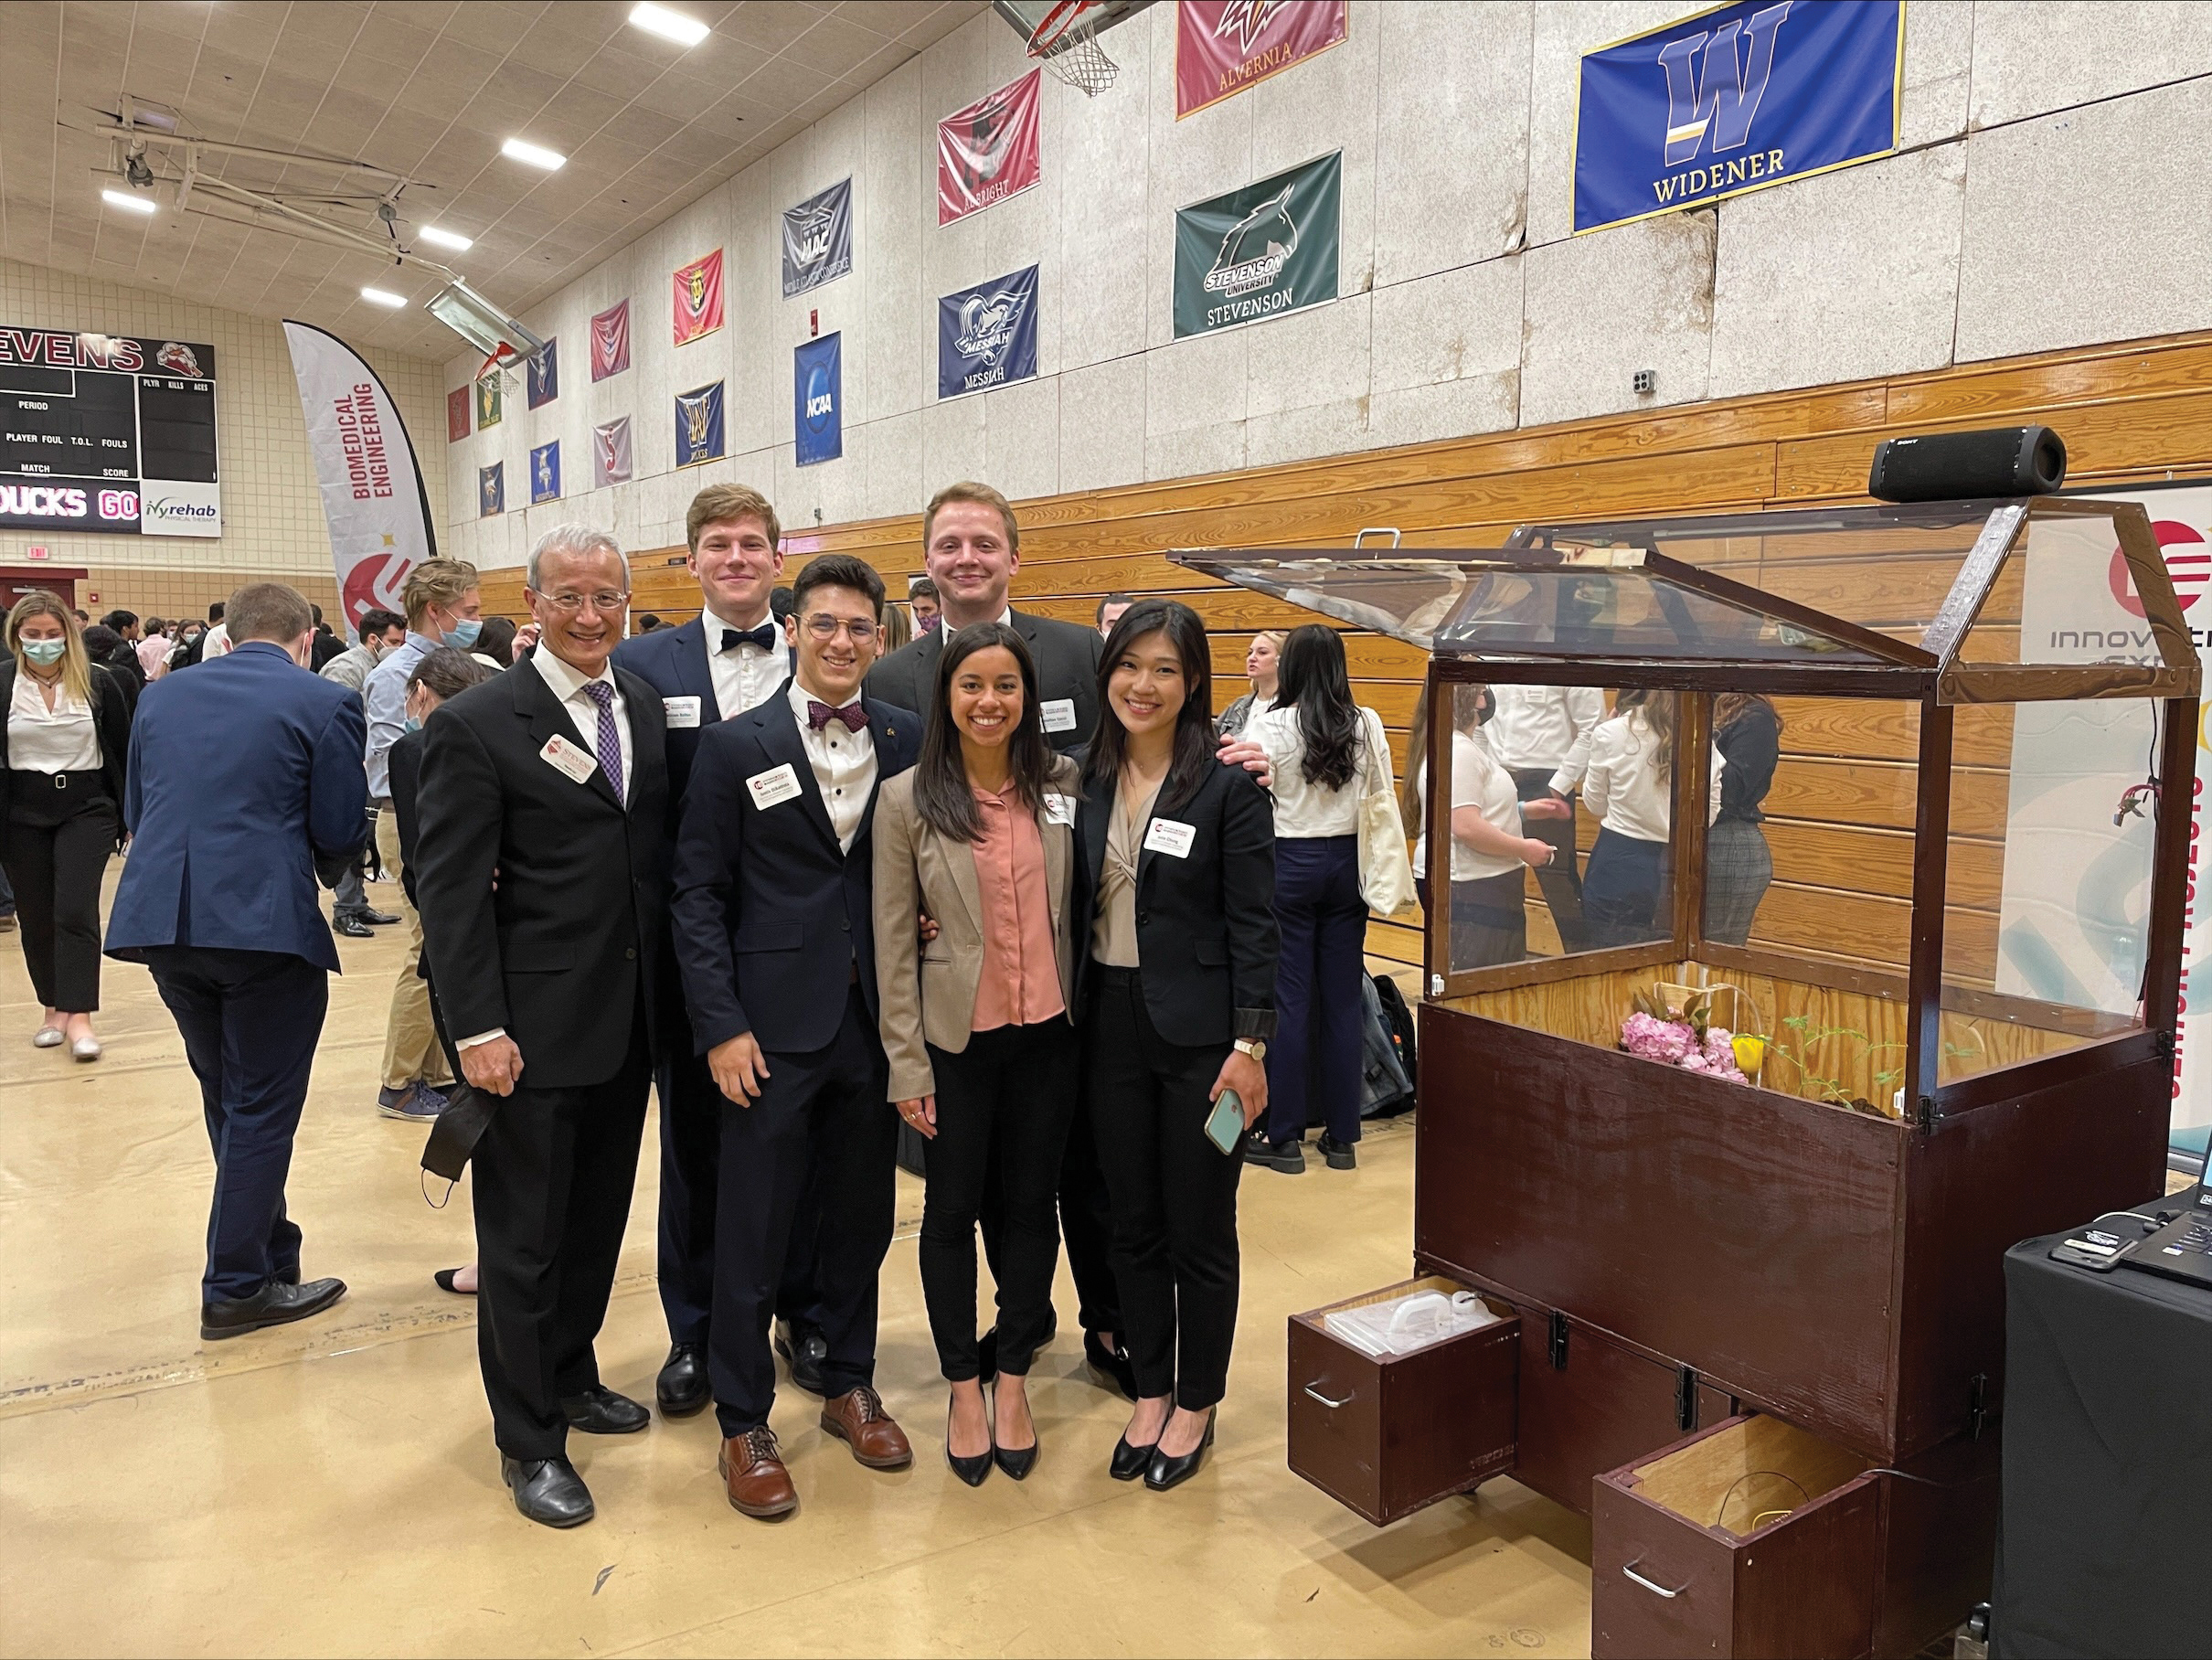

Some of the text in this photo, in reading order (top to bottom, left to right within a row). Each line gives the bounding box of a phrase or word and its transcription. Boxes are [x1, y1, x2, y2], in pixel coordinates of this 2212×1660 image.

[1218, 42, 1292, 91] ALVERNIA
[1653, 149, 1784, 203] WIDENER
[964, 179, 1009, 212] ALBRIGHT
[801, 229, 830, 261] MAC
[1206, 254, 1283, 290] STEVENSON
[1228, 273, 1273, 295] UNIVERSITY
[1207, 288, 1293, 326] STEVENSON
[966, 332, 1010, 354] MESSIAH
[143, 378, 160, 388] PLYR
[167, 380, 184, 390] KILLS
[194, 382, 208, 392] ACES
[964, 367, 1005, 389] MESSIAH
[18, 400, 48, 410] PERIOD
[806, 394, 833, 419] NCAA
[6, 432, 63, 444] PLAYER FOUL
[71, 437, 93, 447] T.O.L.
[101, 439, 127, 449] FOULS
[335, 395, 370, 500] BIOMEDICAL
[354, 383, 393, 498] ENGINEERING
[21, 463, 50, 474] MATCH
[103, 468, 129, 478] SCORE
